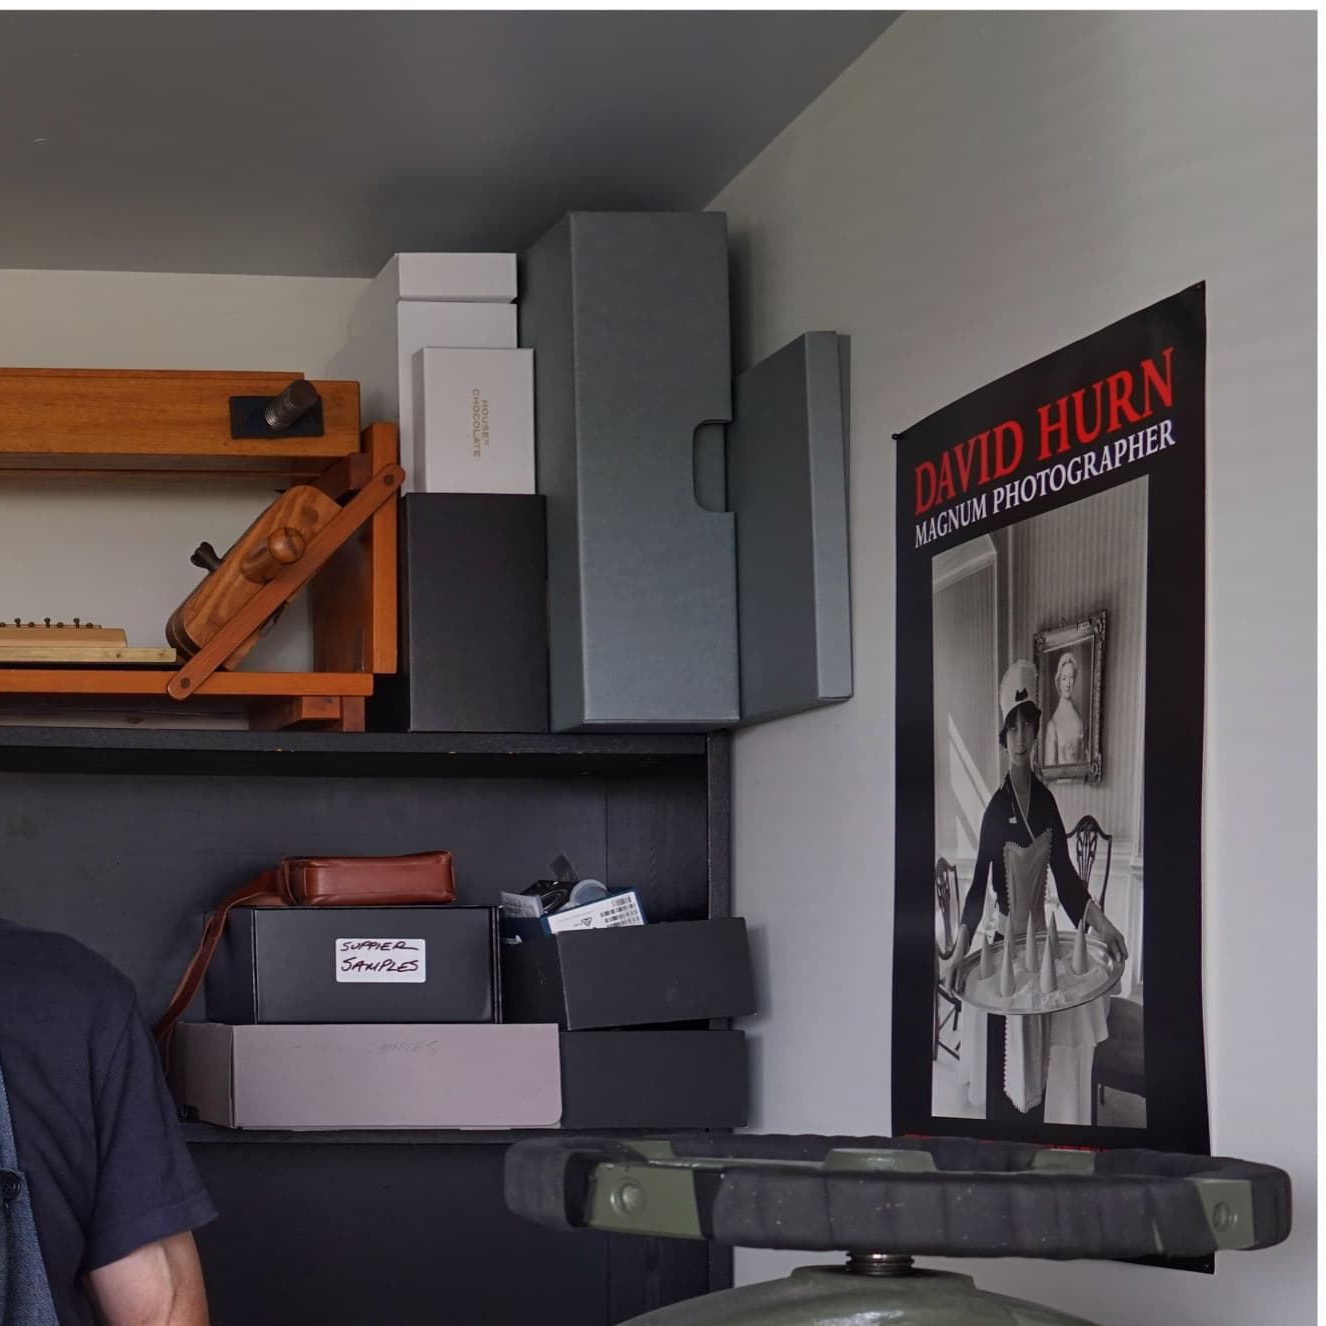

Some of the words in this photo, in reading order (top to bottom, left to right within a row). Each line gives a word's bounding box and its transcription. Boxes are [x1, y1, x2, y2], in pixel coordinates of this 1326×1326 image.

[472, 388, 480, 457] CHOCOLATE
[481, 400, 489, 439] HOUSE
[915, 420, 1024, 516] DAVID
[1037, 347, 1173, 461] HURN
[915, 494, 988, 549] MAGNUM
[992, 418, 1176, 515] PHOTOGRAPHER
[341, 957, 418, 972] SAMPLES
